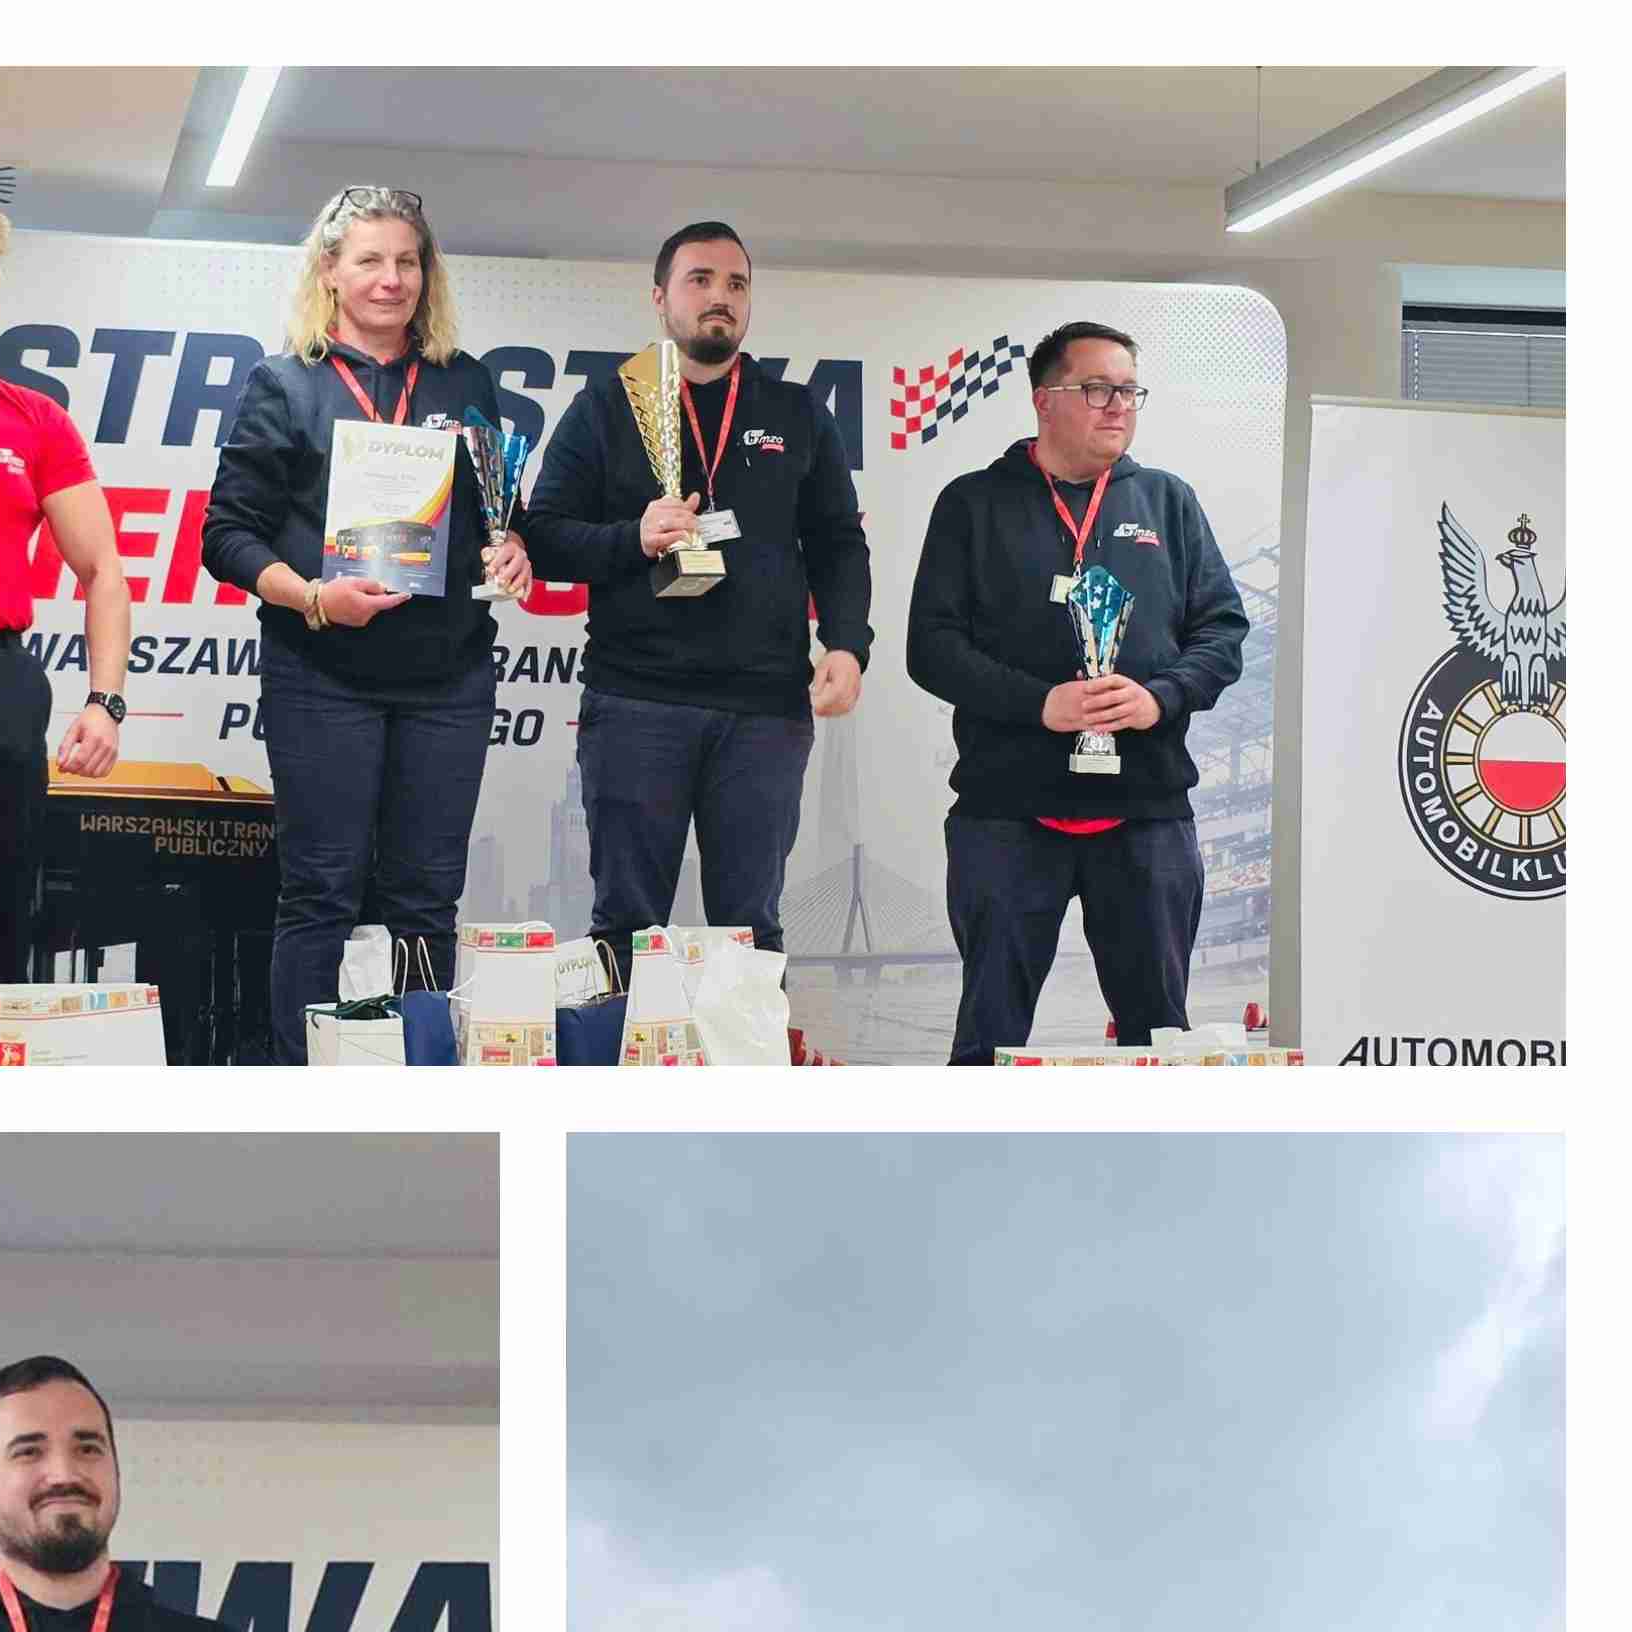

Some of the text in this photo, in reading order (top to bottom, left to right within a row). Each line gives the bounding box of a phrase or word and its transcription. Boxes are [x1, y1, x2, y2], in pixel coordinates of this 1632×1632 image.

[367, 441, 445, 461] DYPLOM
[79, 814, 214, 837] WARSZAWSKI
[154, 836, 269, 857] PUBLICZNY
